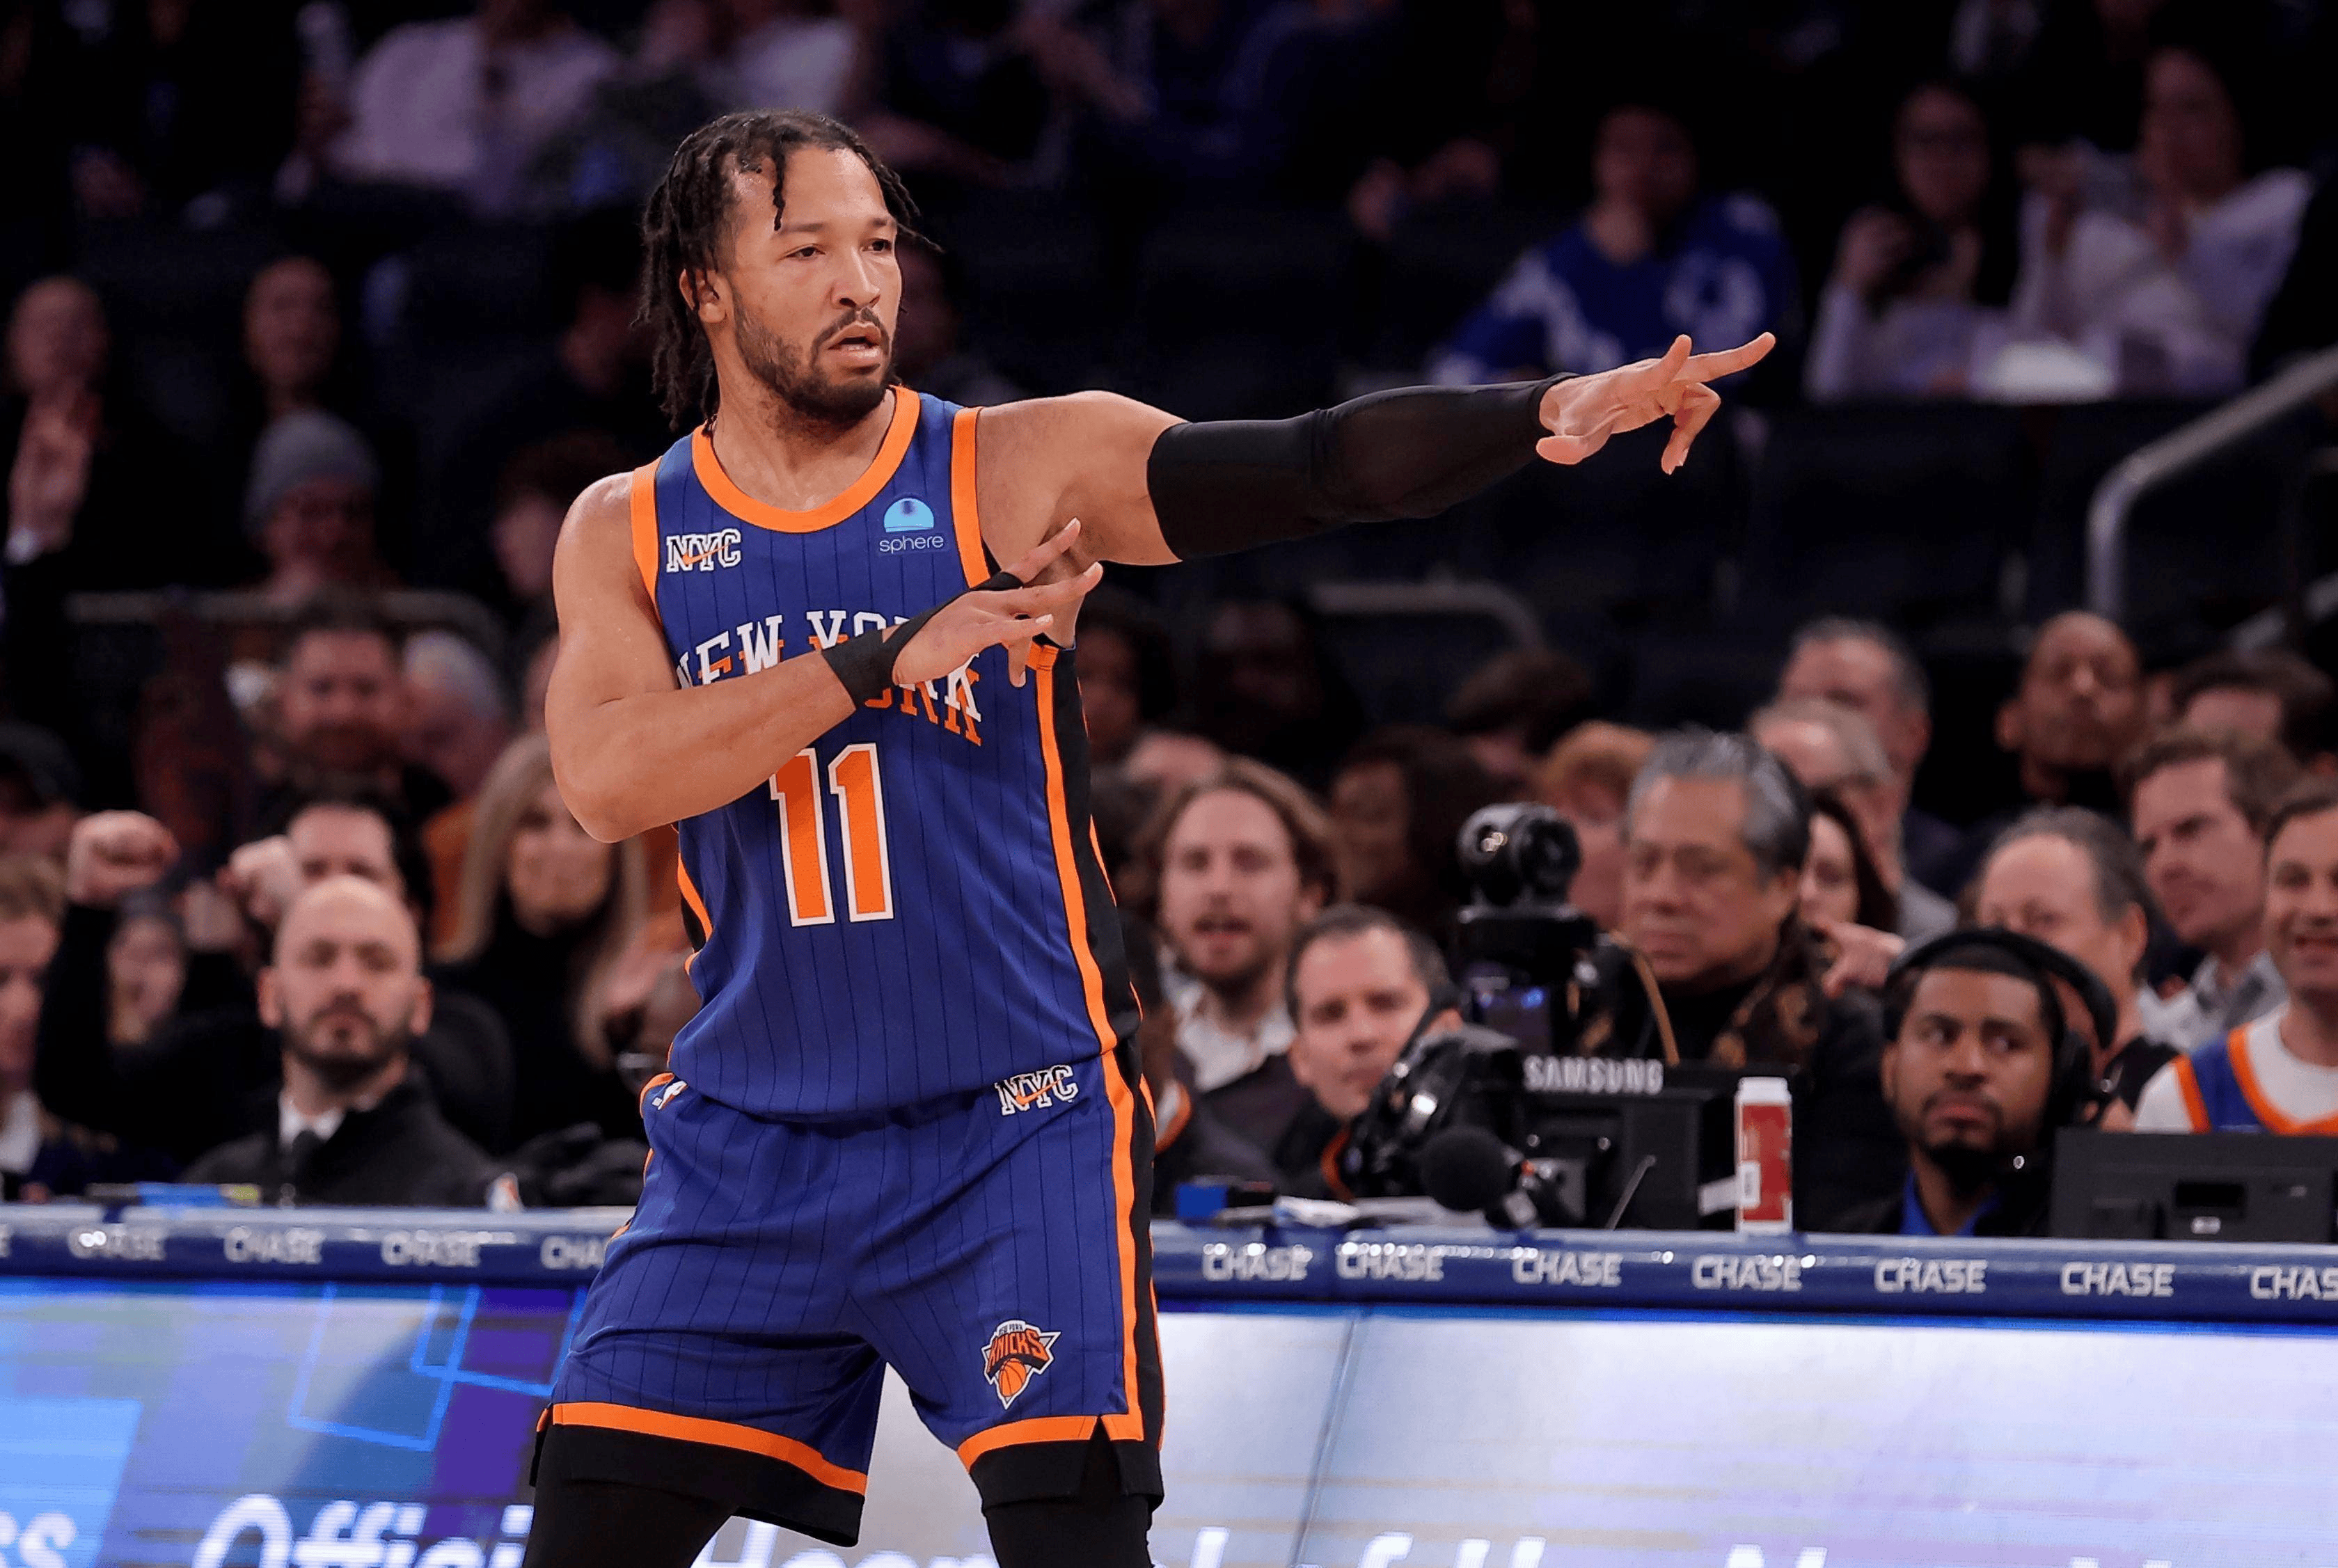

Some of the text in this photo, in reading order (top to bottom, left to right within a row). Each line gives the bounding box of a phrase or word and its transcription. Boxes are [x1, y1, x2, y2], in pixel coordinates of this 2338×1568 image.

[666, 528, 741, 573] NYC
[879, 535, 944, 554] sphere
[769, 743, 894, 928] 11
[994, 1064, 1079, 1116] NYC
[1524, 1055, 1664, 1095] SAMSUNG
[1203, 1246, 1309, 1281] CHASE
[1336, 1246, 1444, 1281] CHASE
[1512, 1250, 1622, 1288] CHASE
[1691, 1255, 1802, 1292] CHASE
[1874, 1258, 1988, 1294] CHASE
[2061, 1261, 2175, 1298] CHASE
[987, 1328, 1049, 1373] KNICKS
